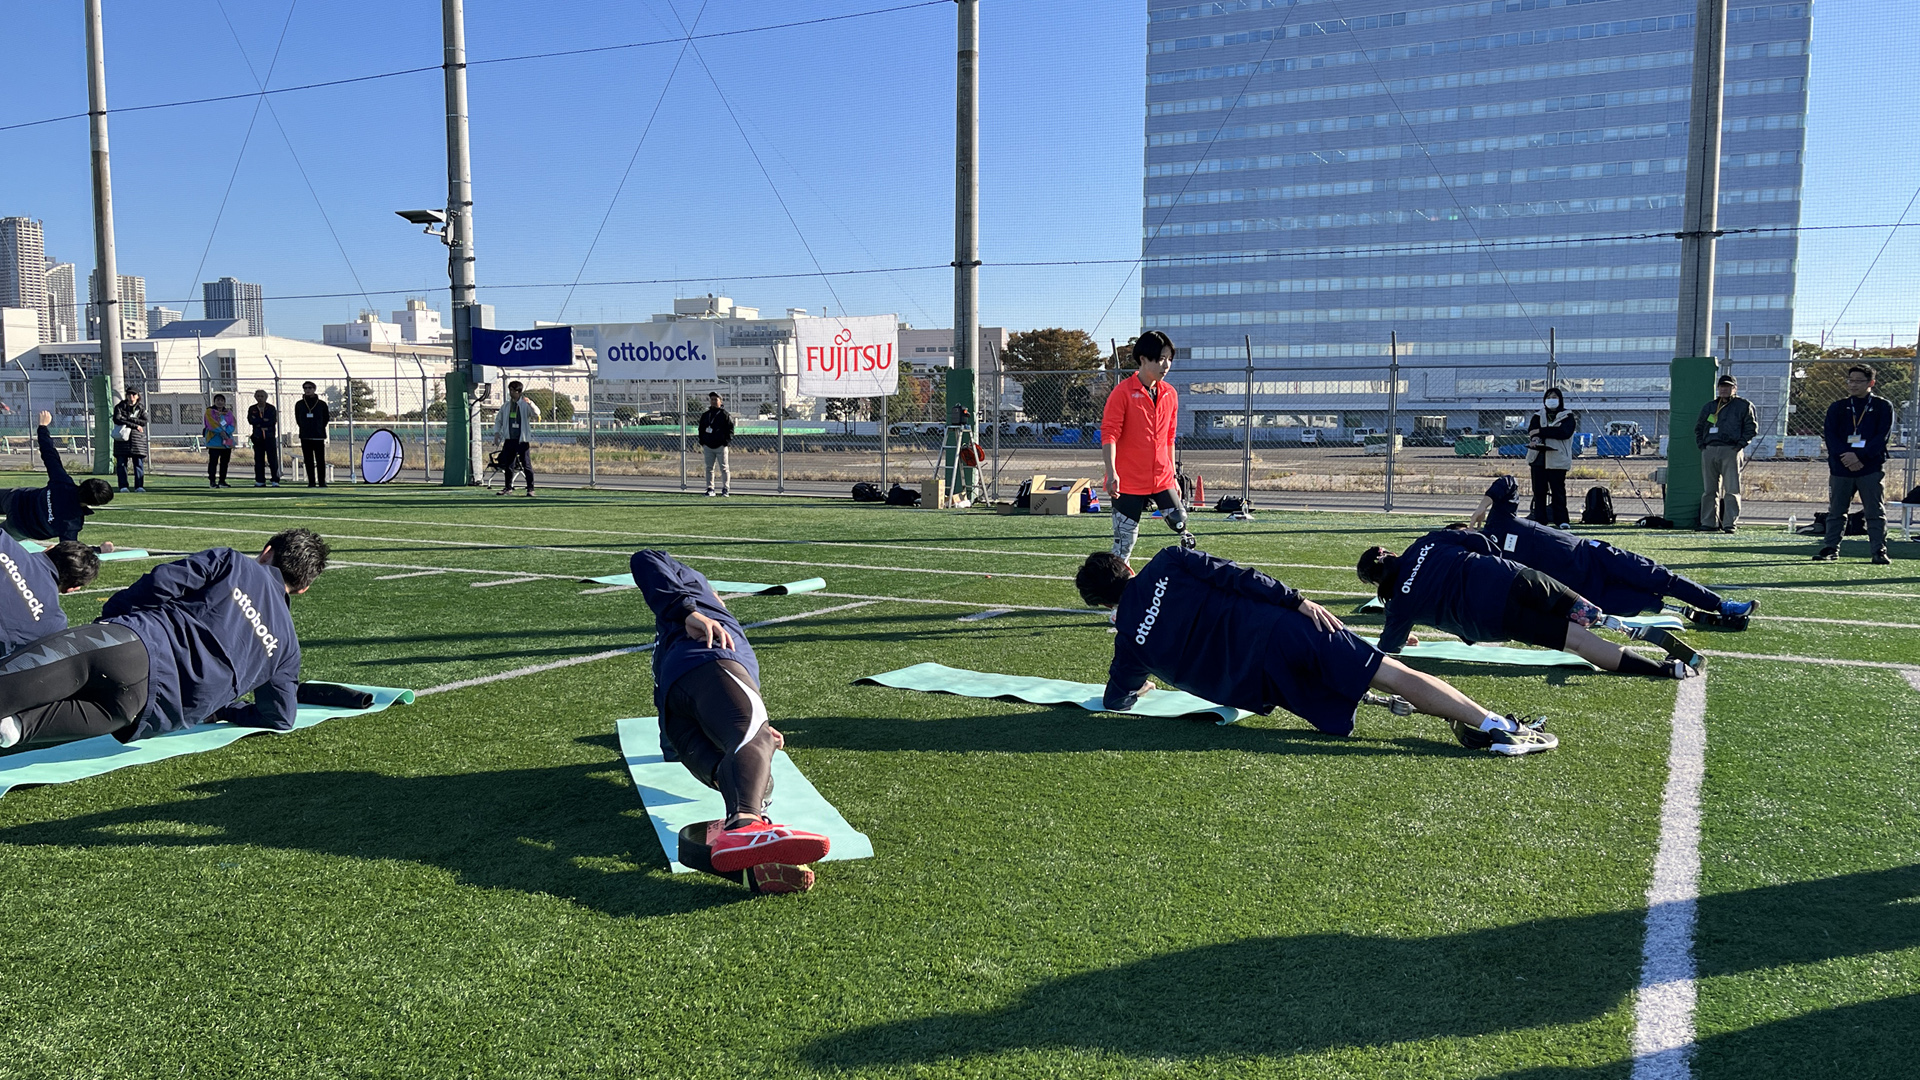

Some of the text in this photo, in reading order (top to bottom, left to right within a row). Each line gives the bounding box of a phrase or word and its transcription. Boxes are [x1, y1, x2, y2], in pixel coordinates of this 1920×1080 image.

[608, 340, 707, 362] ottobock.
[806, 342, 892, 381] FUJITSU
[0, 552, 44, 622] ottobock.
[1135, 576, 1169, 645] ottobock.
[233, 587, 278, 657] ottobock.
